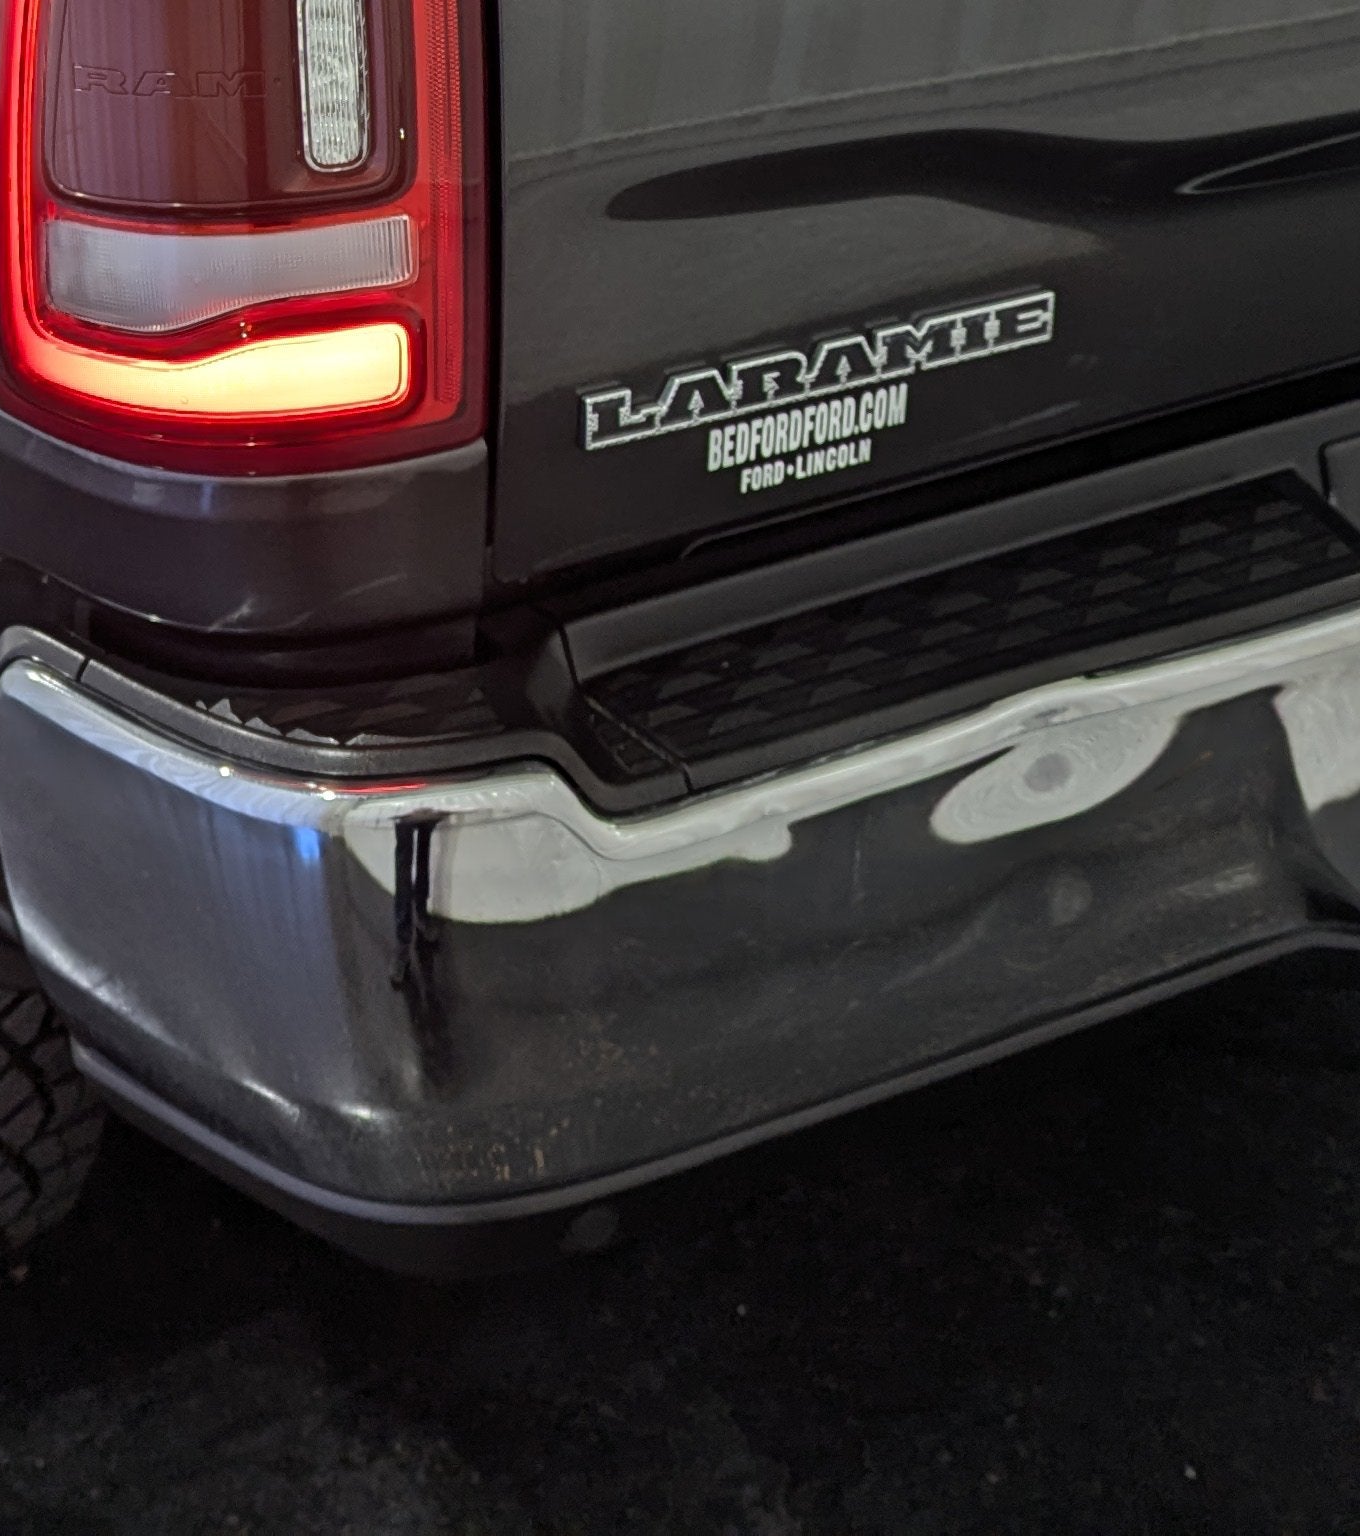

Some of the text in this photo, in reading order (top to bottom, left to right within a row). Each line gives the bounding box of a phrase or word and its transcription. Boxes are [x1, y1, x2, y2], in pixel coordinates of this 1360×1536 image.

[73, 66, 268, 98] RAM
[582, 289, 1055, 451] LARAMIE
[707, 383, 908, 472] BEDFORDFORD.COM
